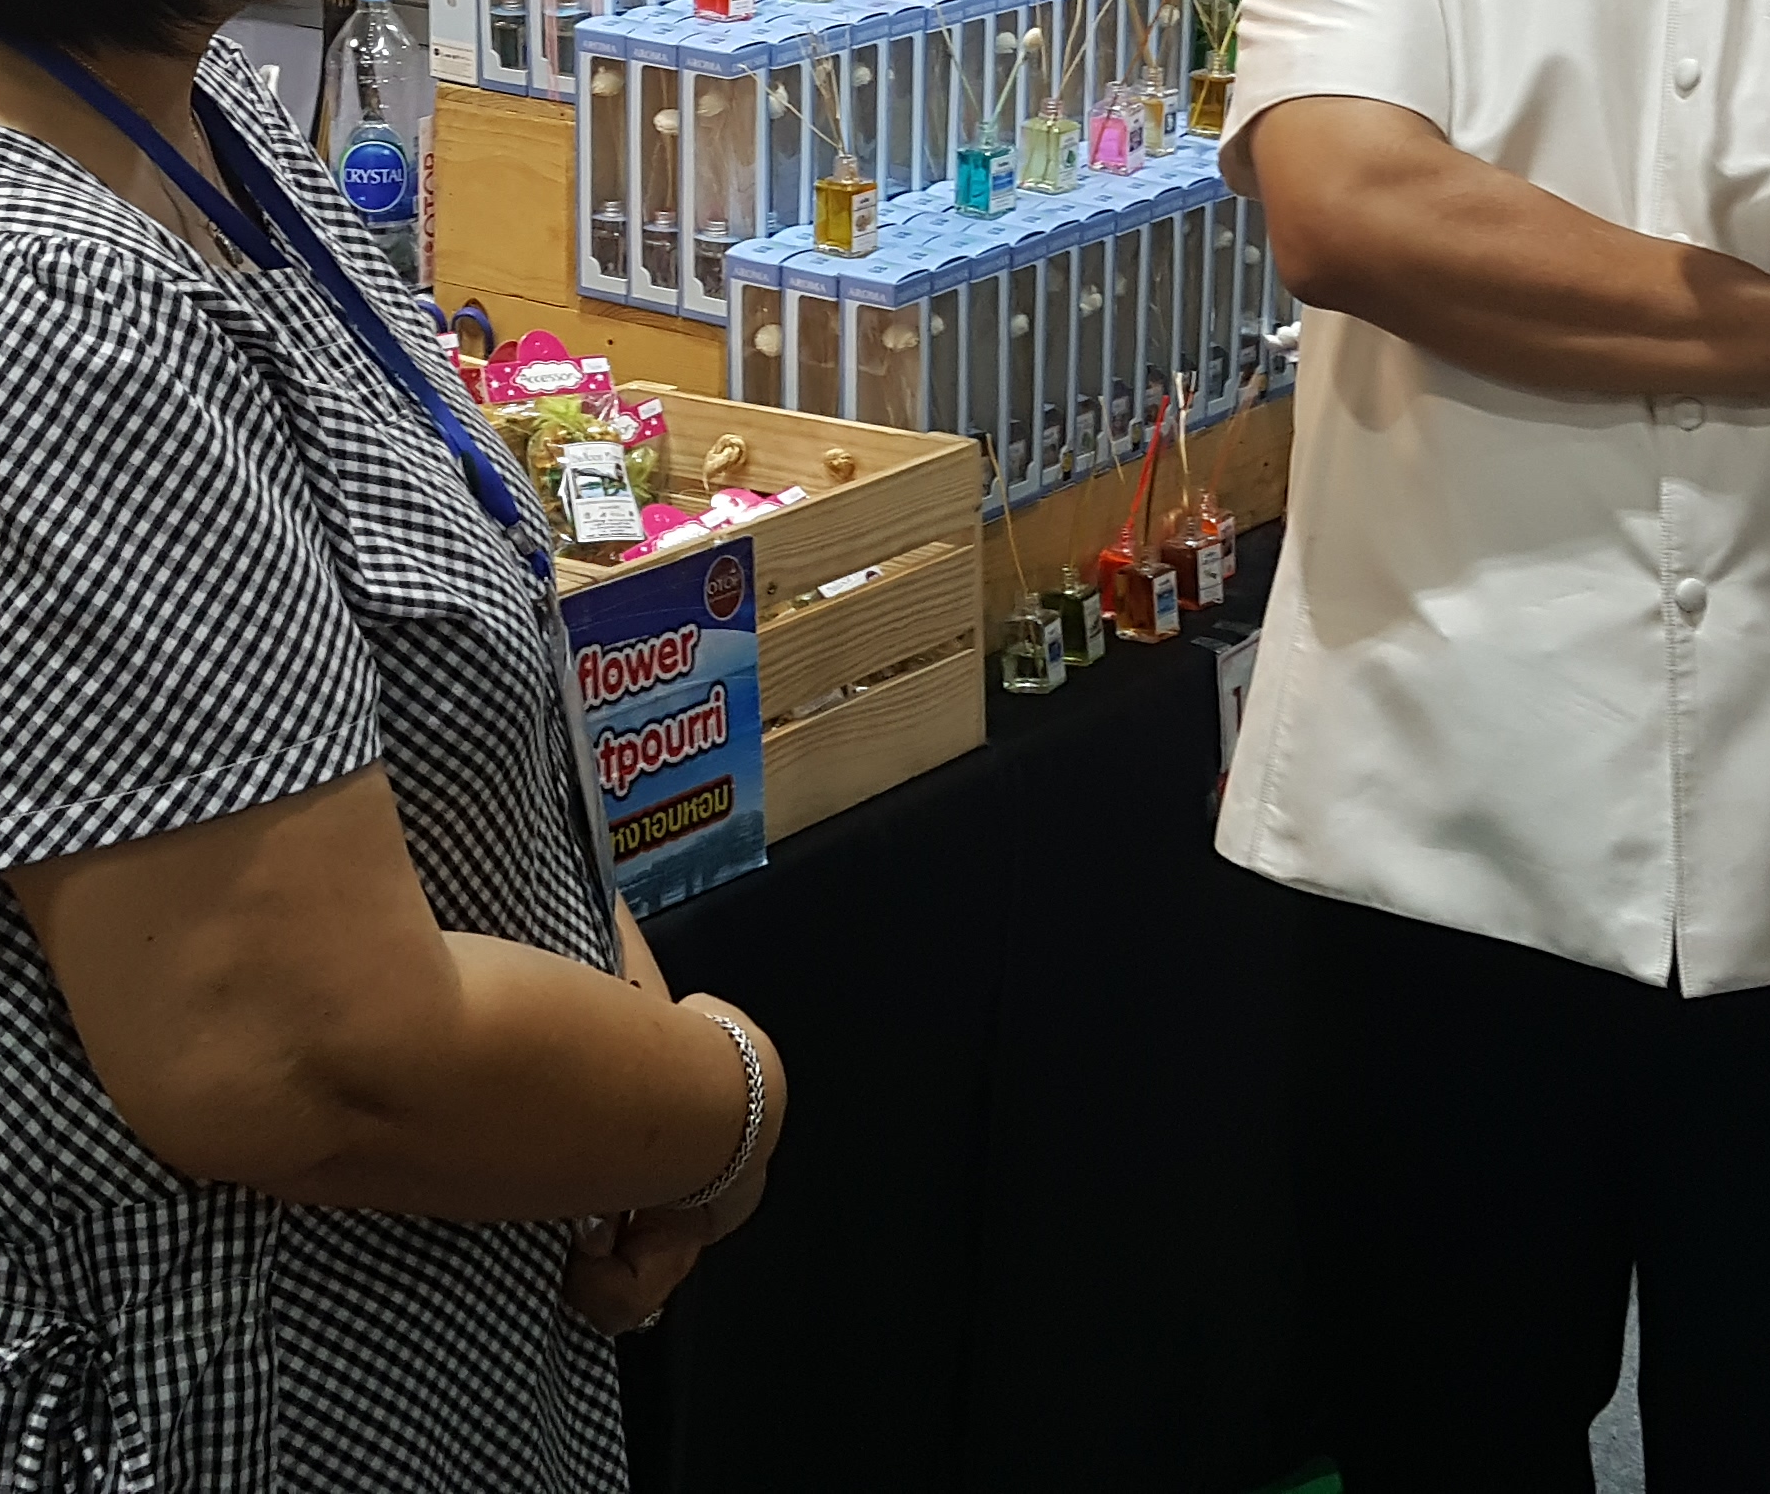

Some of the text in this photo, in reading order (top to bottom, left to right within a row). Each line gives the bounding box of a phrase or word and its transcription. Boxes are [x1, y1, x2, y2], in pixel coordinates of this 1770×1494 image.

[344, 167, 405, 185] CRYSTAL
[578, 626, 696, 706] flower
[597, 688, 725, 794] tpourri
